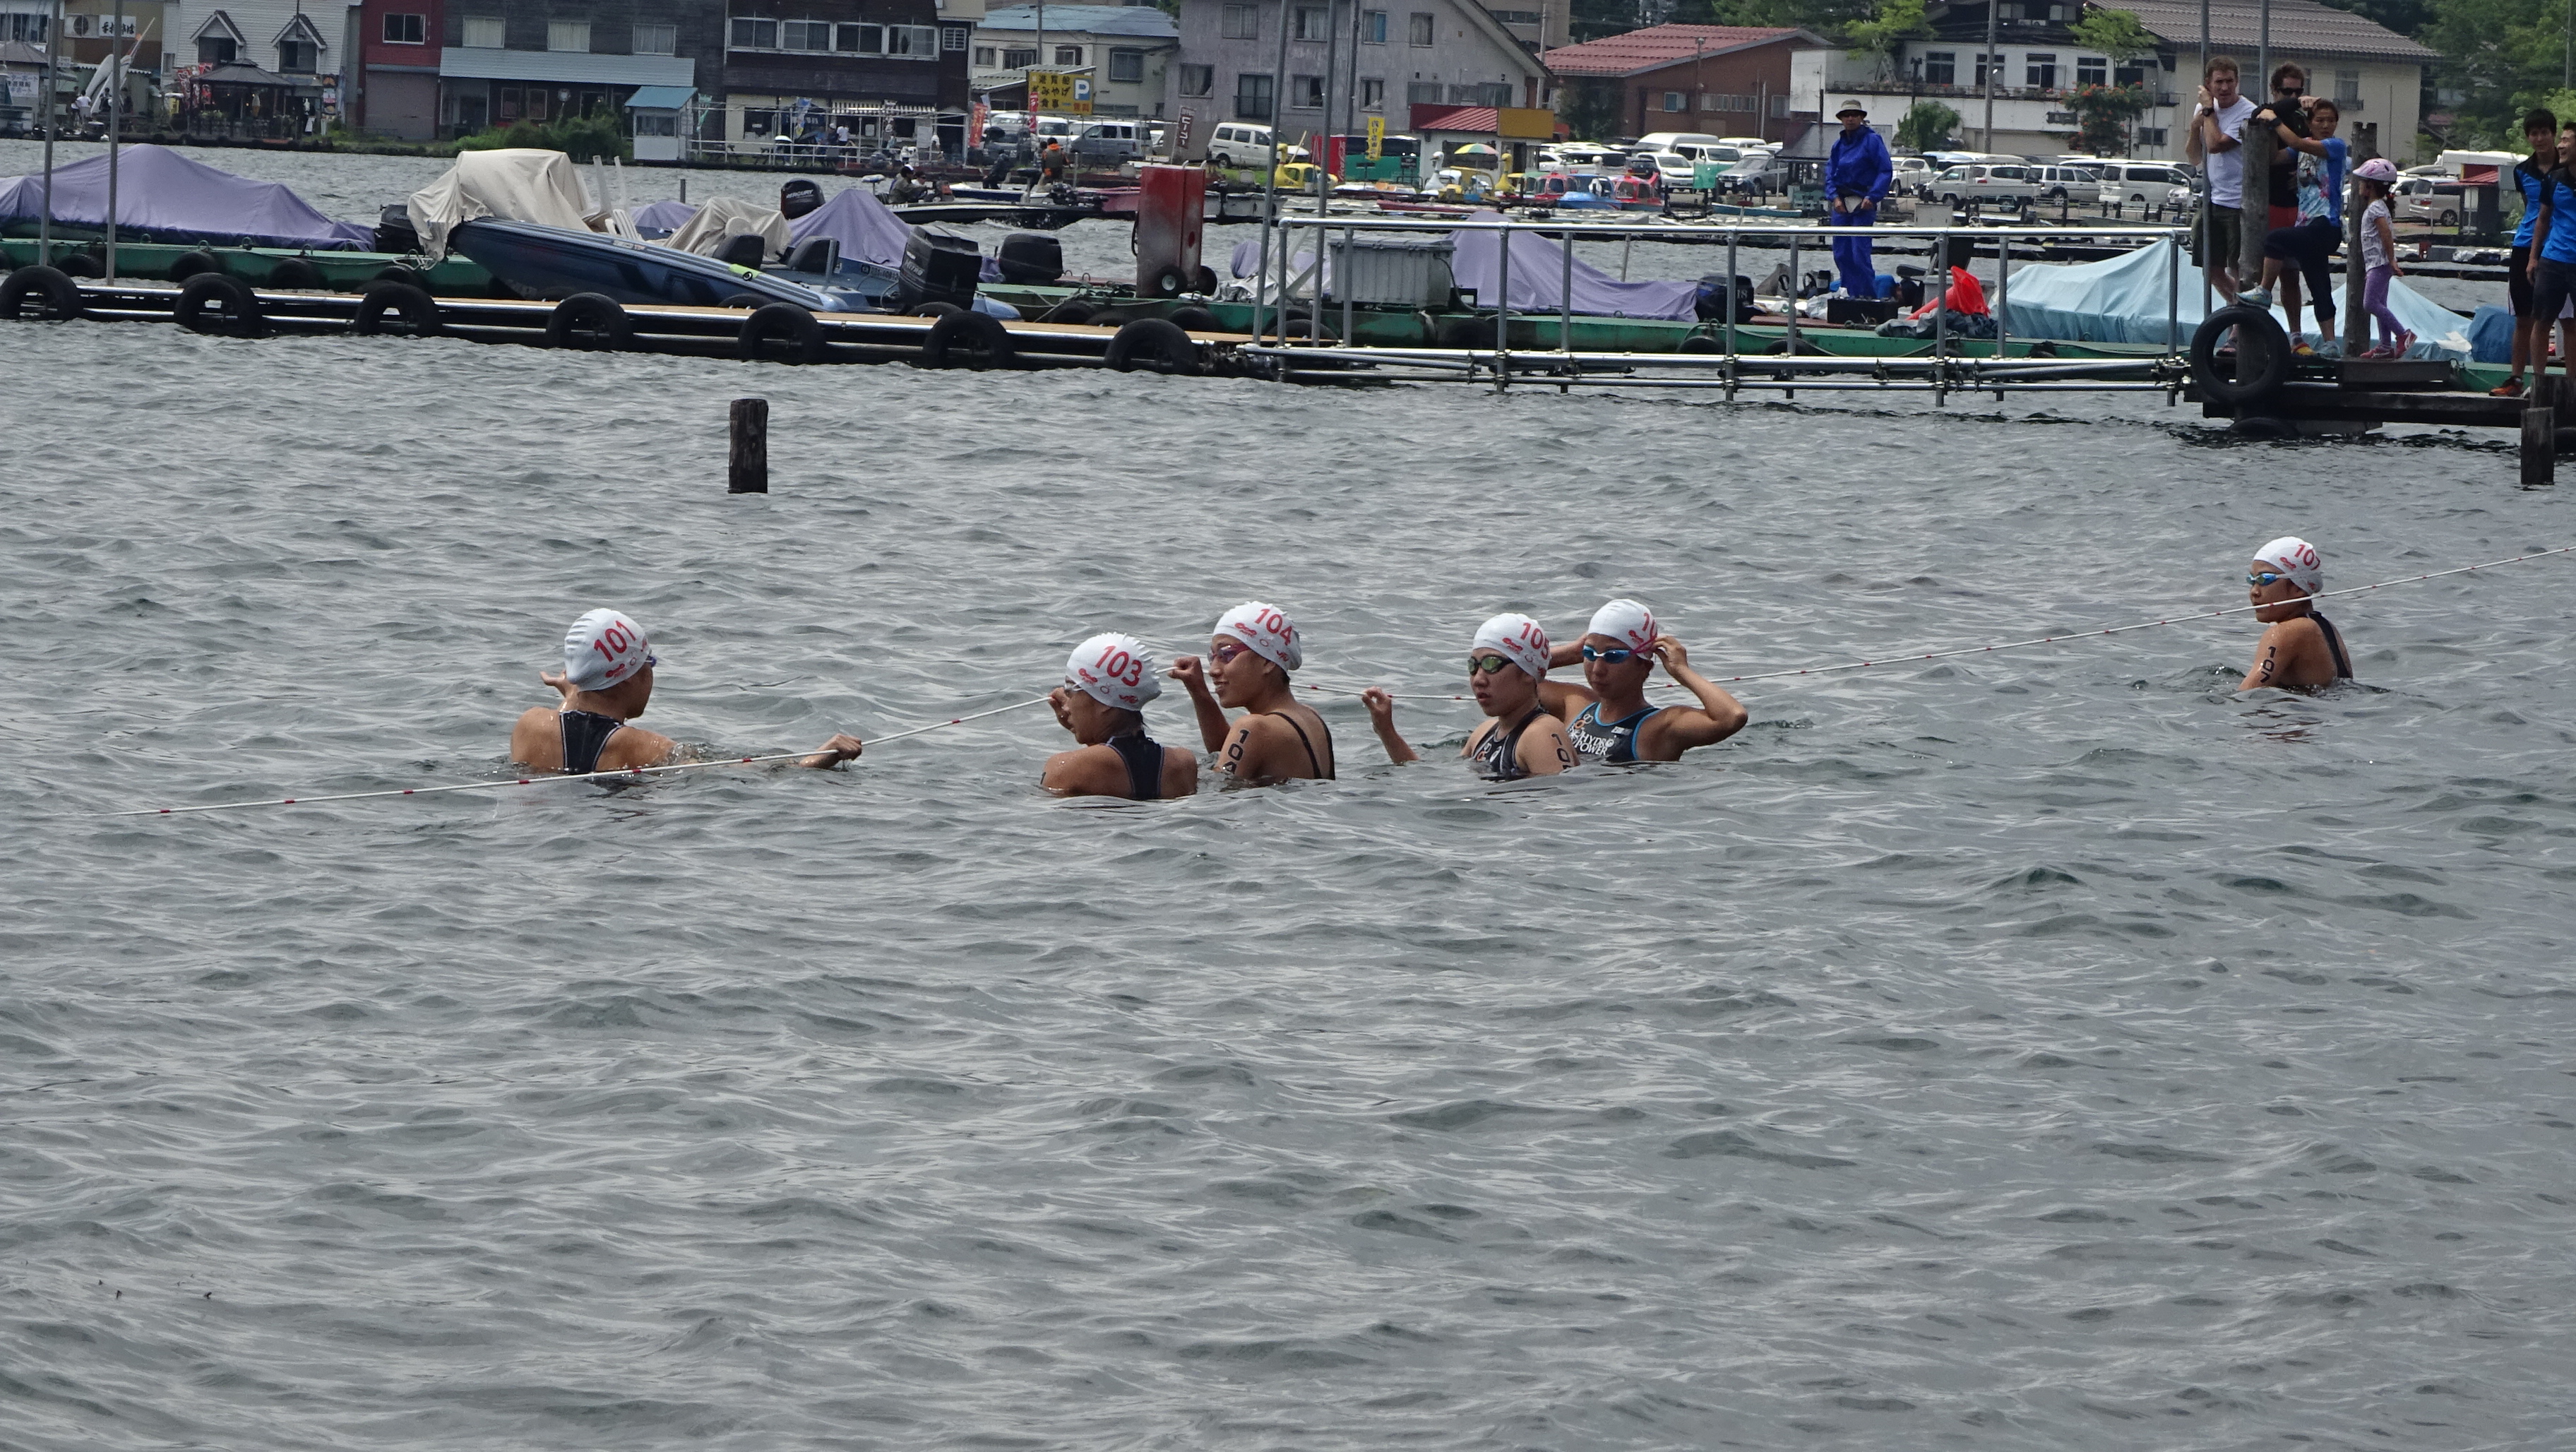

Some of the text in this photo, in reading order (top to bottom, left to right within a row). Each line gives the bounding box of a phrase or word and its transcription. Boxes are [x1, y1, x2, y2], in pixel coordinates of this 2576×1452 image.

[1075, 79, 1090, 100] P
[594, 620, 636, 662] 101
[1254, 608, 1292, 646] 104
[1520, 622, 1549, 660] 105
[1095, 645, 1143, 687] 103
[2260, 646, 2277, 683] 107
[1574, 739, 1608, 756] POWER
